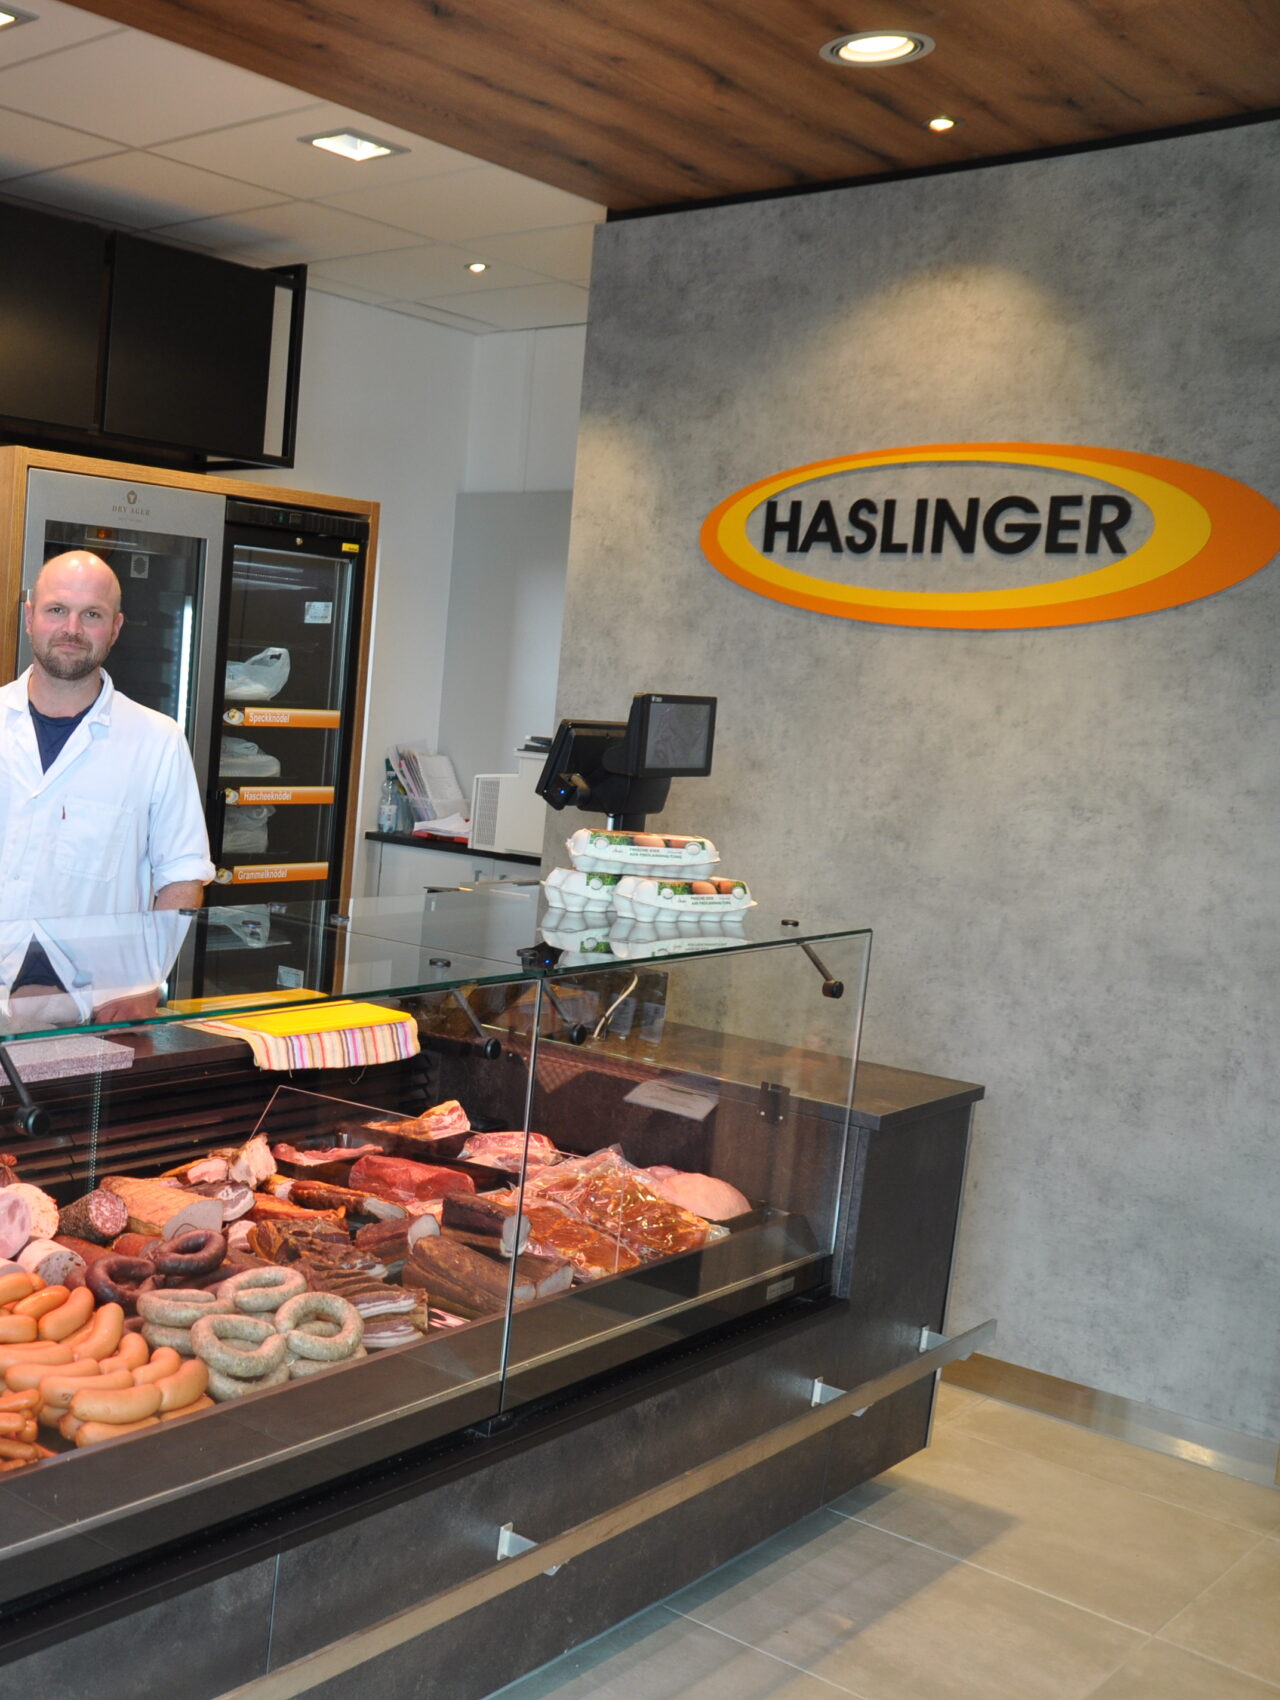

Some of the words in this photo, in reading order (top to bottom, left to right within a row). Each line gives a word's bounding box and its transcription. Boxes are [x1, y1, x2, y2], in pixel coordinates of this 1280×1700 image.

[762, 494, 1133, 556] HASLINGER
[248, 711, 290, 725] Speckknödel
[243, 790, 292, 802] Hascheeknödel
[237, 868, 288, 881] Grammelknödel
